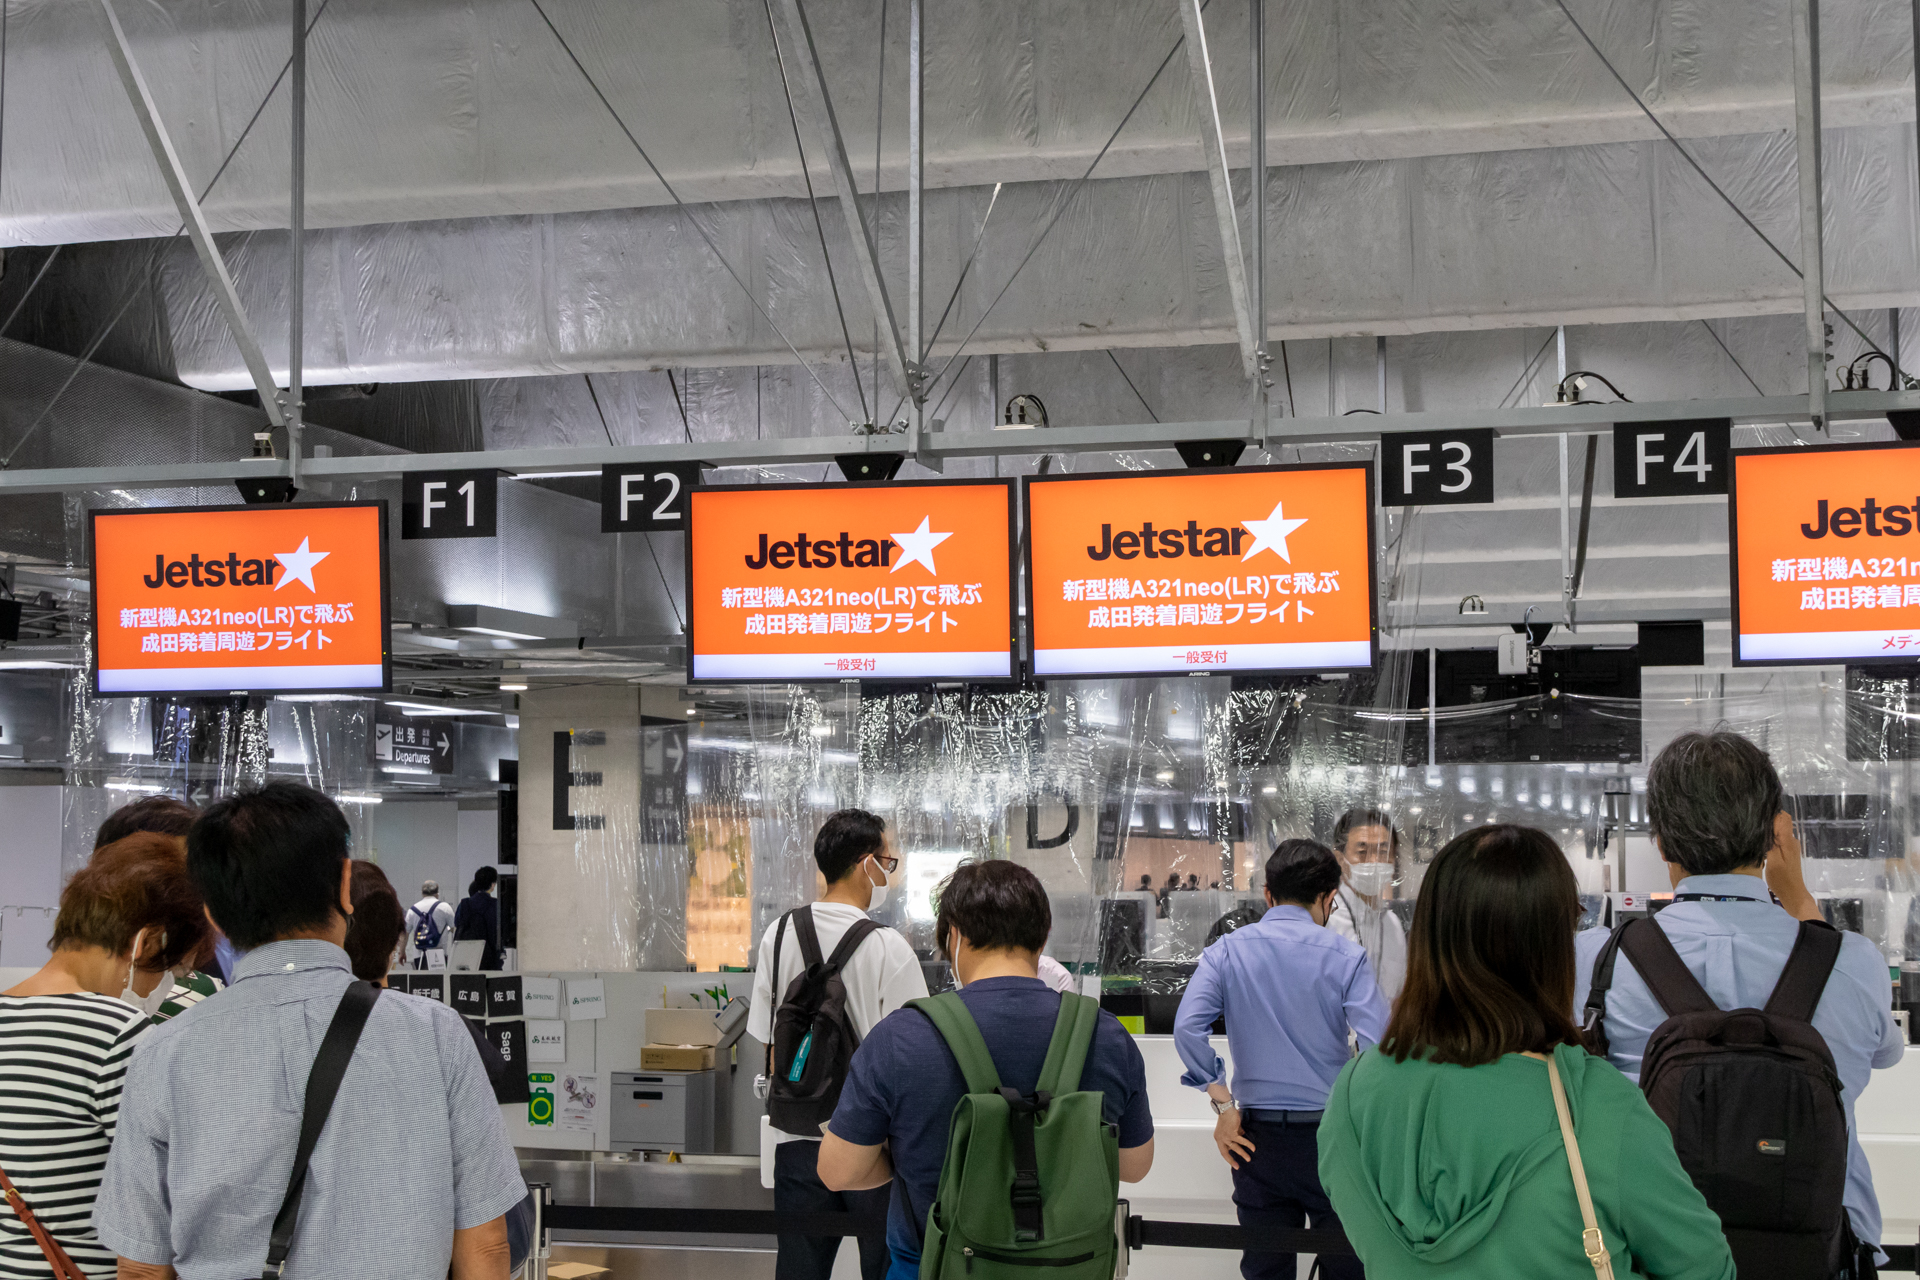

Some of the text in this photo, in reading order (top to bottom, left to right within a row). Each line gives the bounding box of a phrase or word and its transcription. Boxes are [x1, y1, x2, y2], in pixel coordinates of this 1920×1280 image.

[1403, 441, 1473, 494] F3
[1636, 431, 1712, 485] F4
[423, 480, 475, 528] F1
[620, 472, 681, 521] F2
[745, 532, 897, 570] Jetstar
[1087, 520, 1249, 561] Jetstar
[143, 552, 280, 589] Jetstar
[721, 583, 982, 610] 新型機A321neo(LR)で飛ぶ
[1063, 570, 1340, 602] 新型機A321neo(LR)で飛ぶ
[120, 602, 353, 628] 新型機A321neo(LR)で飛ぶ
[745, 611, 958, 635] 成田発着周遊フライト
[1088, 600, 1314, 629] 成田発着周遊フライト
[141, 629, 332, 653] 成田発着周遊フライト
[824, 658, 876, 672] 一般受付
[1172, 650, 1228, 664] 一般受付
[395, 749, 431, 764] Departures
[553, 731, 606, 830] E
[1026, 779, 1079, 849] D
[458, 990, 480, 1002] 広島
[493, 990, 516, 1002] 佐賀
[500, 1031, 512, 1061] Saga
